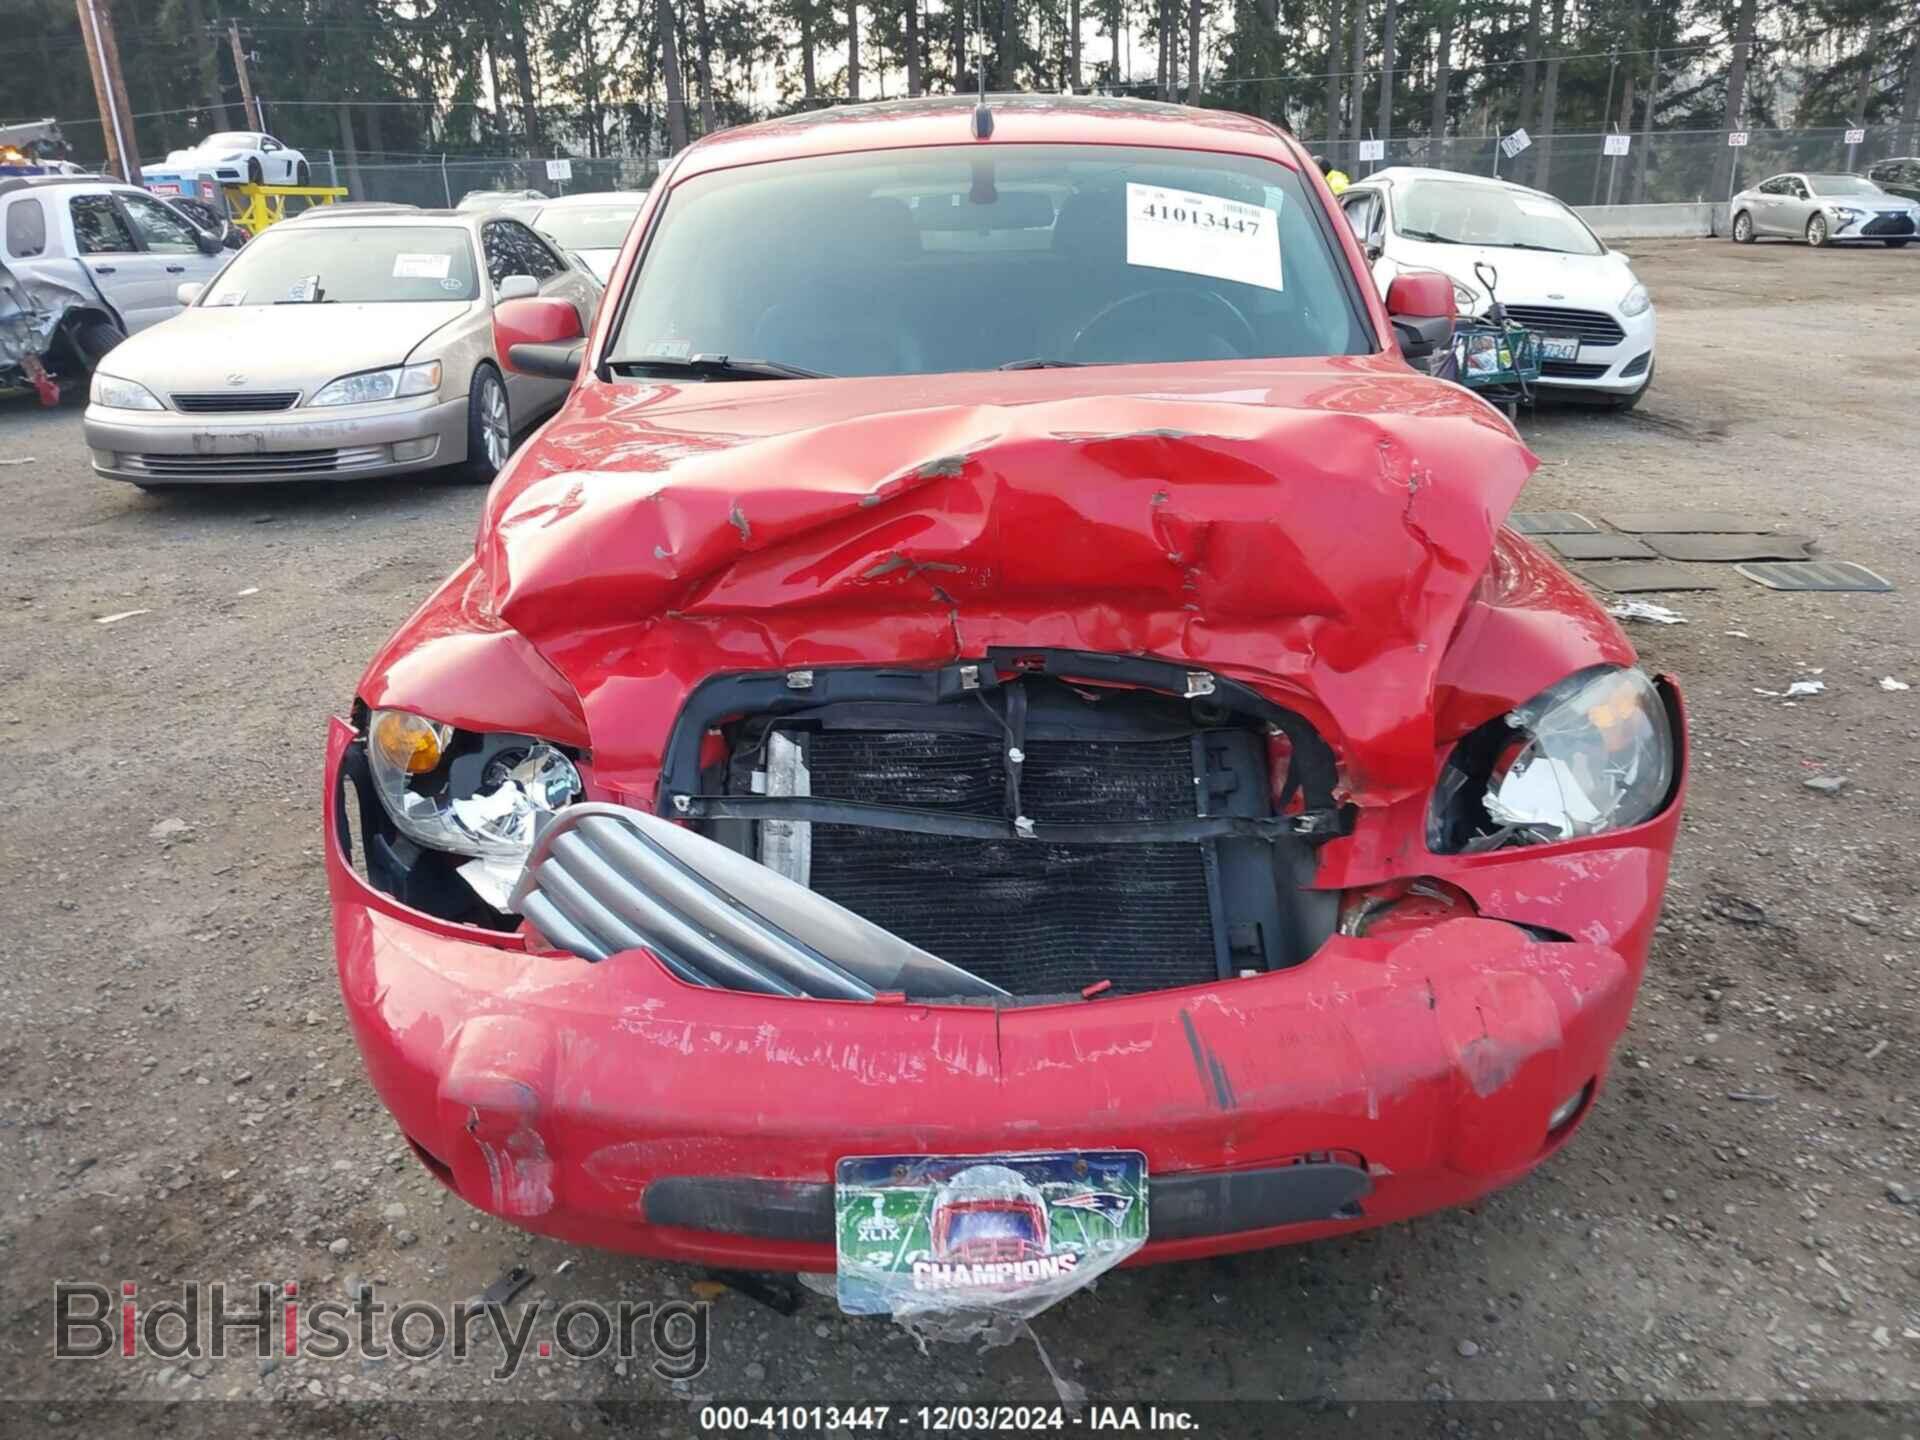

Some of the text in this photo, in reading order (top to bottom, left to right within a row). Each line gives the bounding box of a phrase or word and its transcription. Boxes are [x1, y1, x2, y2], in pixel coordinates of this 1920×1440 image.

[1142, 203, 1260, 237] 41013447
[857, 1228, 901, 1242] XLIX
[911, 1252, 1078, 1291] CHAMPIONS
